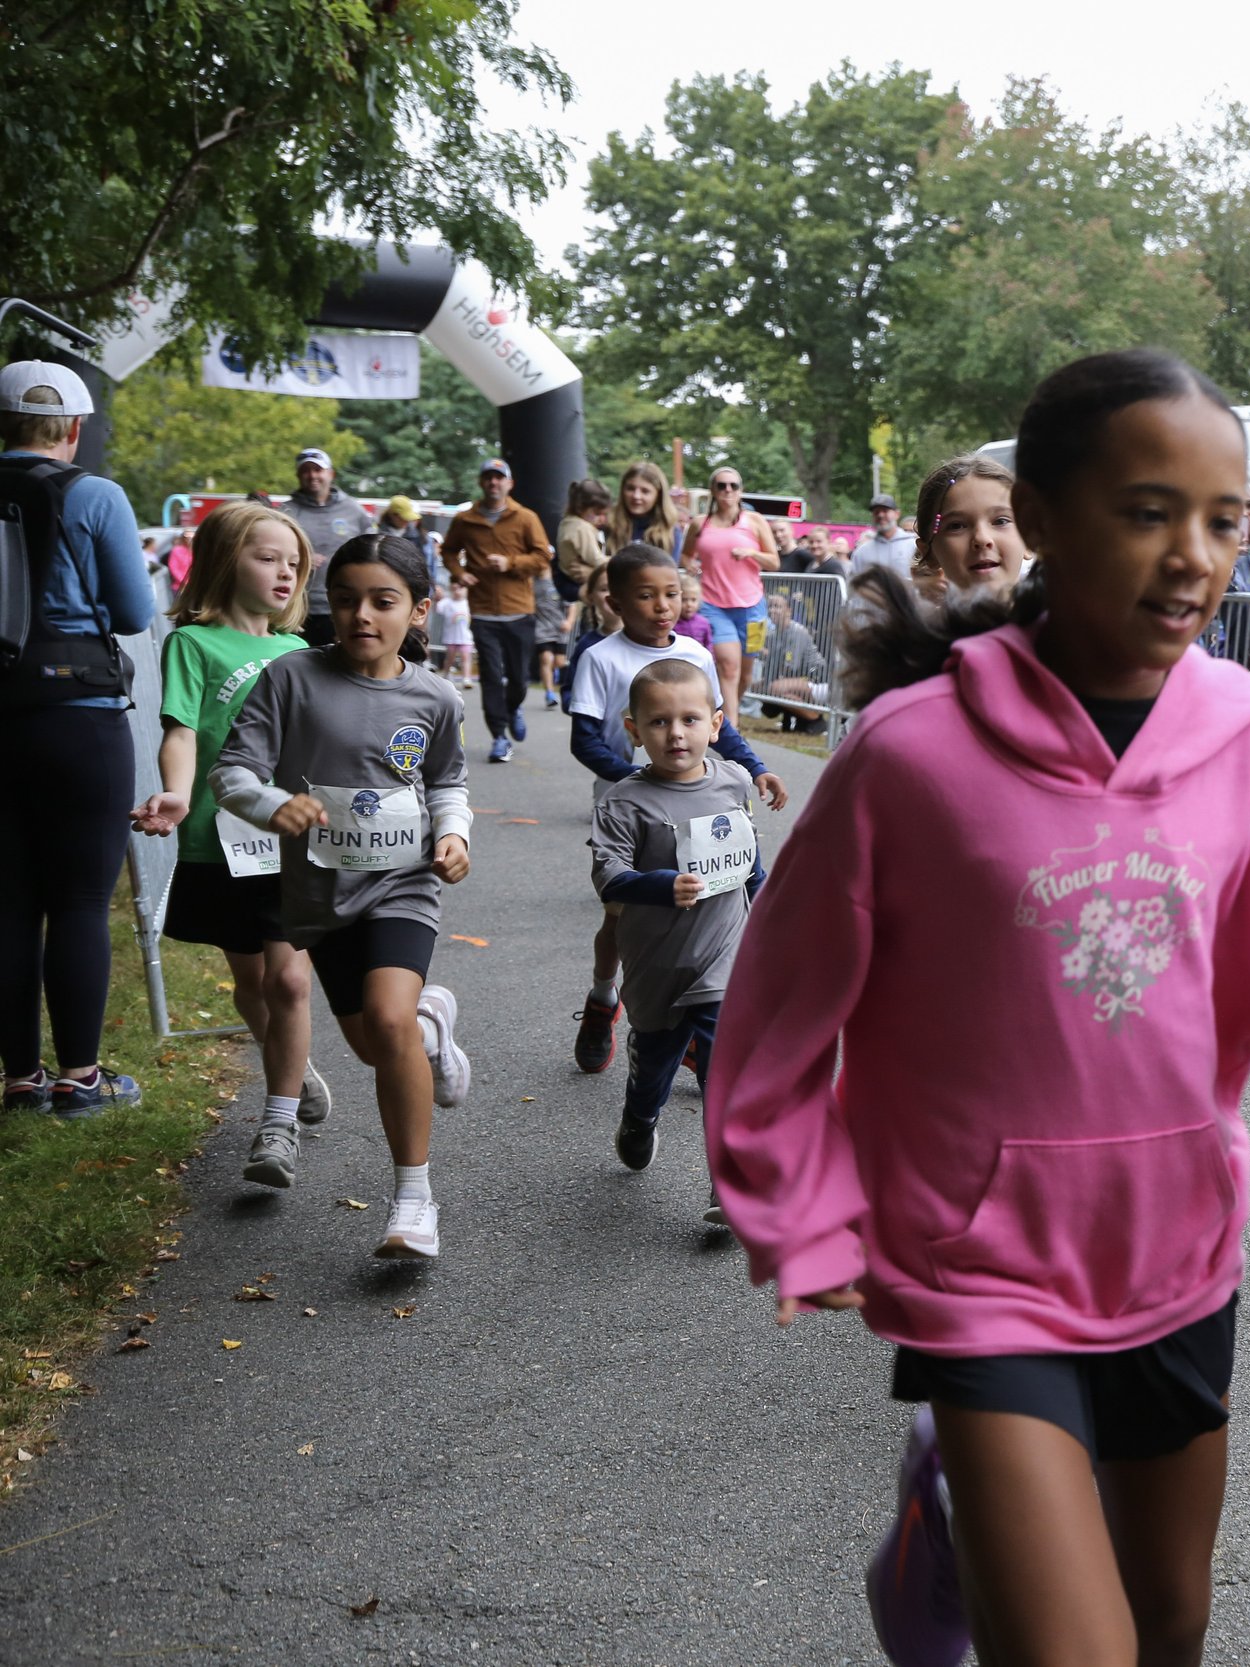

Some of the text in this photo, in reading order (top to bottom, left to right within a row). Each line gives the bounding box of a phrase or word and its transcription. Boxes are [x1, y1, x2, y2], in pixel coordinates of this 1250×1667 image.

[453, 296, 543, 386] High5EM
[216, 661, 260, 704] HERE
[231, 838, 273, 857] FUN
[318, 828, 414, 848] FUN RUN
[352, 855, 391, 863] DUFFY
[687, 848, 752, 875] FUN RUN
[1032, 851, 1206, 908] Flower Market
